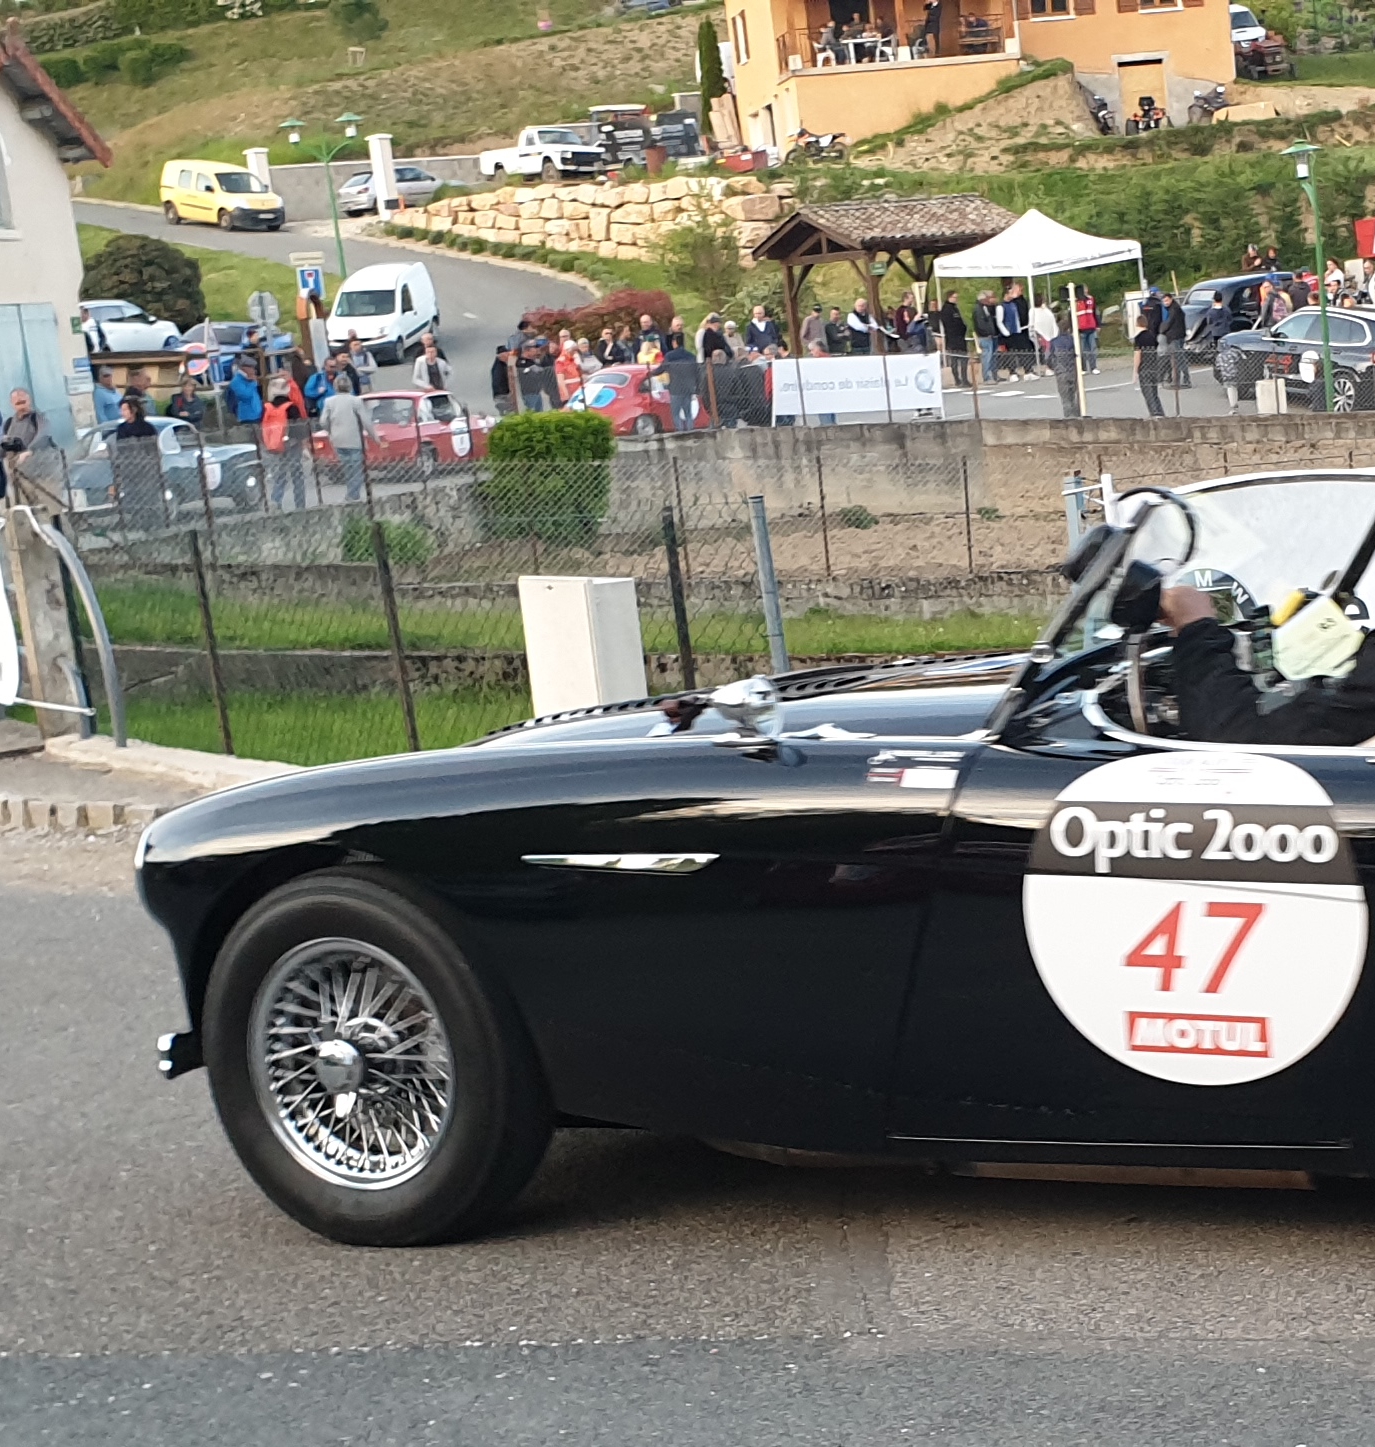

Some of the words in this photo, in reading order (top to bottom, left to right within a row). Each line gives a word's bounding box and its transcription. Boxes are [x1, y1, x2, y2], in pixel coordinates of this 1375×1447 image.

[1050, 806, 1194, 873] Optic
[1200, 809, 1339, 863] 2000
[1121, 901, 1268, 993] 47
[1130, 1017, 1267, 1052] MOTUL
